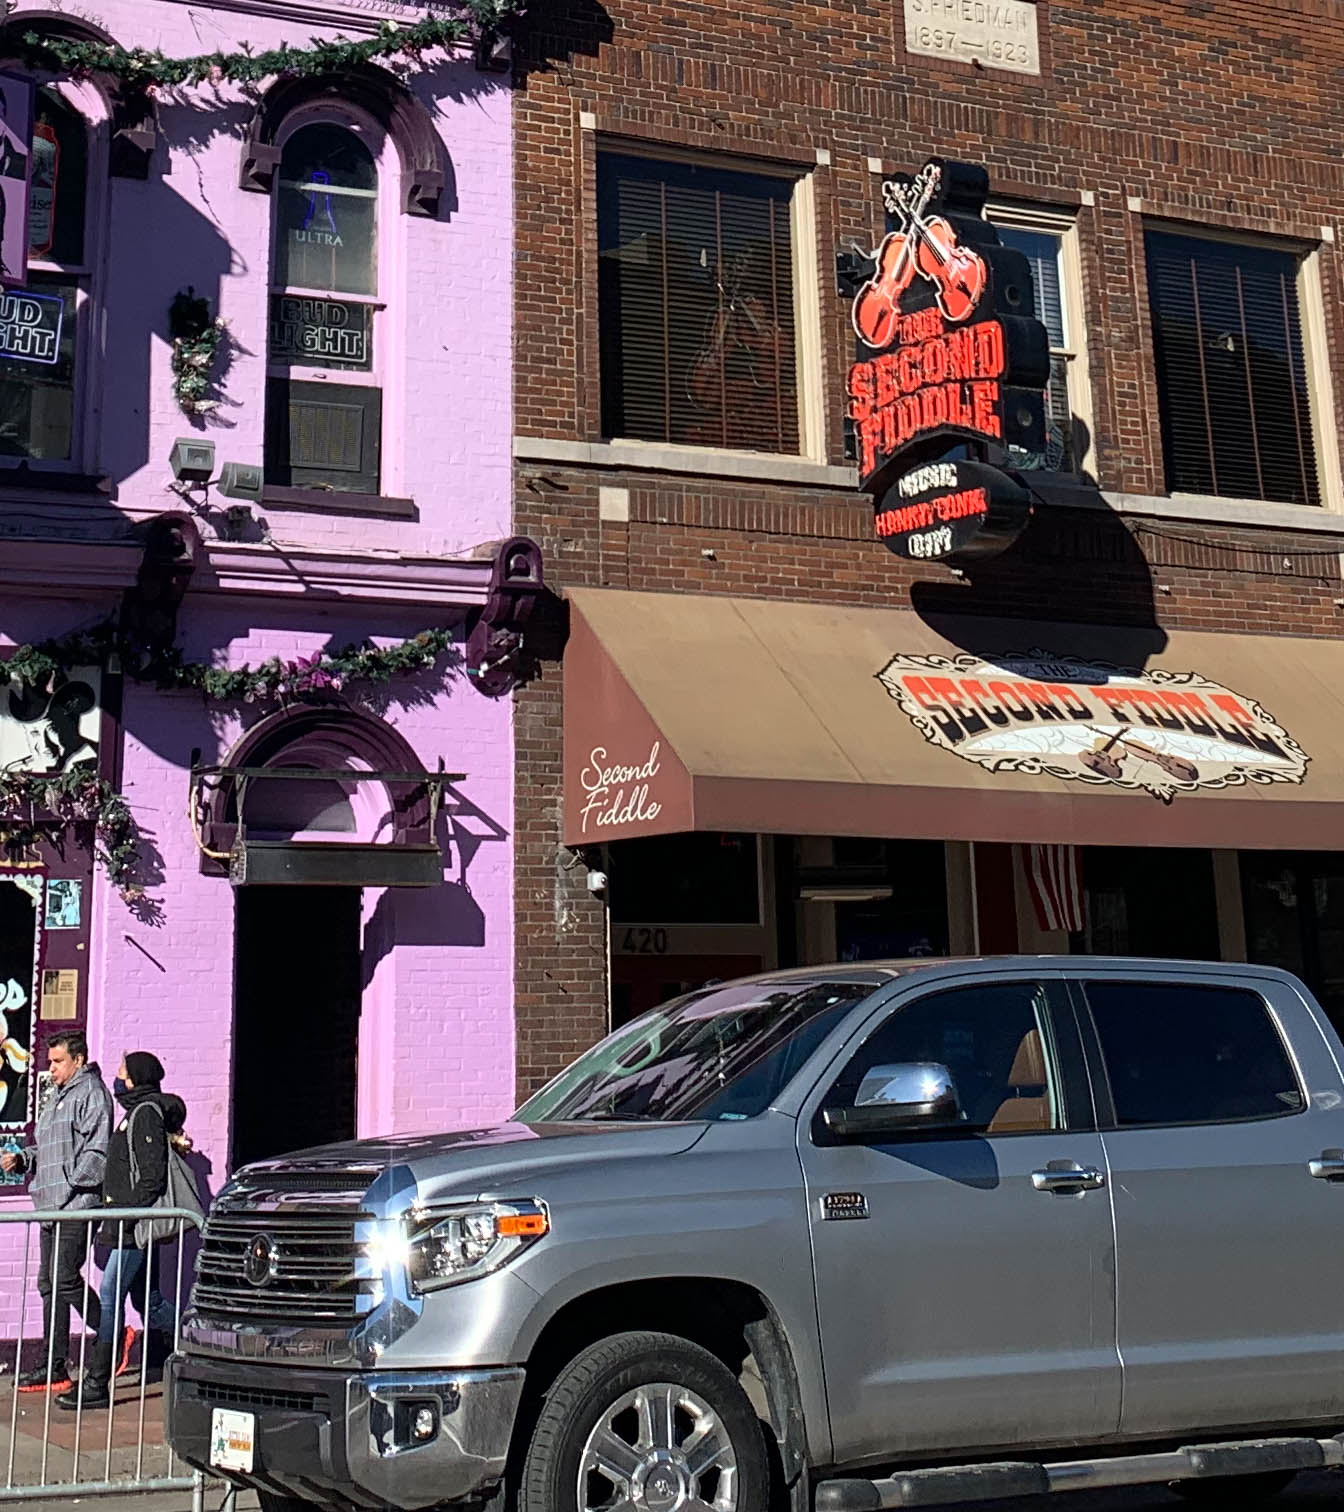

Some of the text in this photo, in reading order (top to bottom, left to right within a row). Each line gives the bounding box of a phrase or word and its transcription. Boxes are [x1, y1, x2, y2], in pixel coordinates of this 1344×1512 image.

[296, 230, 343, 247] ULTRA
[846, 320, 1005, 422] SECOND
[857, 380, 1001, 478] FIDDLE
[1034, 662, 1077, 681] THE
[900, 673, 1294, 764] SECOND FIDDLE
[580, 741, 661, 791] Second
[580, 783, 662, 833] Fiddle
